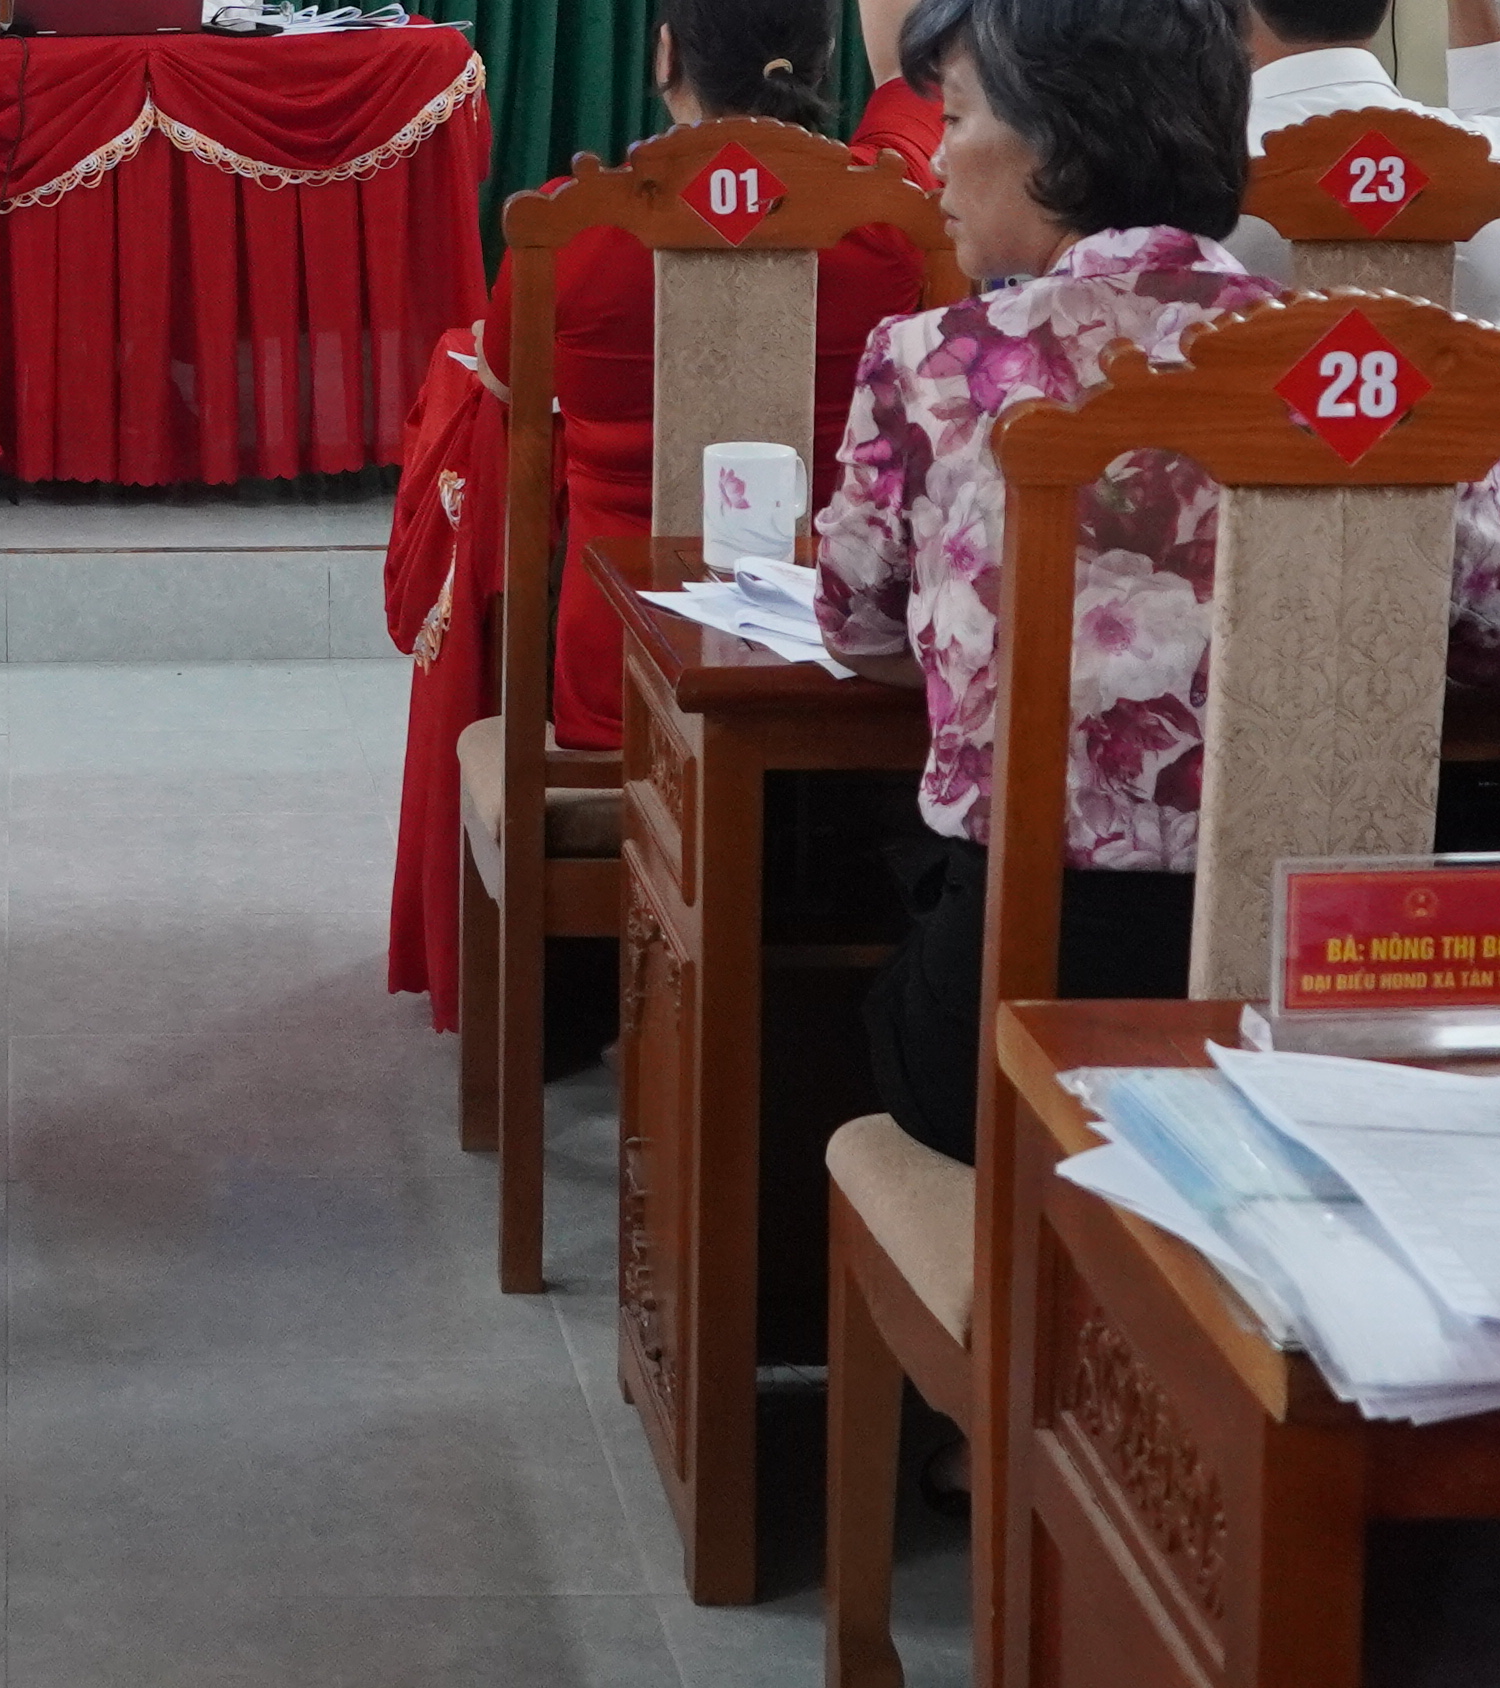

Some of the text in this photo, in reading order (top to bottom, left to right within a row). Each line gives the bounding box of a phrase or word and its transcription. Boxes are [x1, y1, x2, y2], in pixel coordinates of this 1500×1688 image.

[709, 168, 761, 214] 01
[1349, 156, 1406, 204] 23
[1317, 351, 1399, 419] 28
[1327, 934, 1364, 962] BÀ:
[1441, 935, 1476, 965] THỊ
